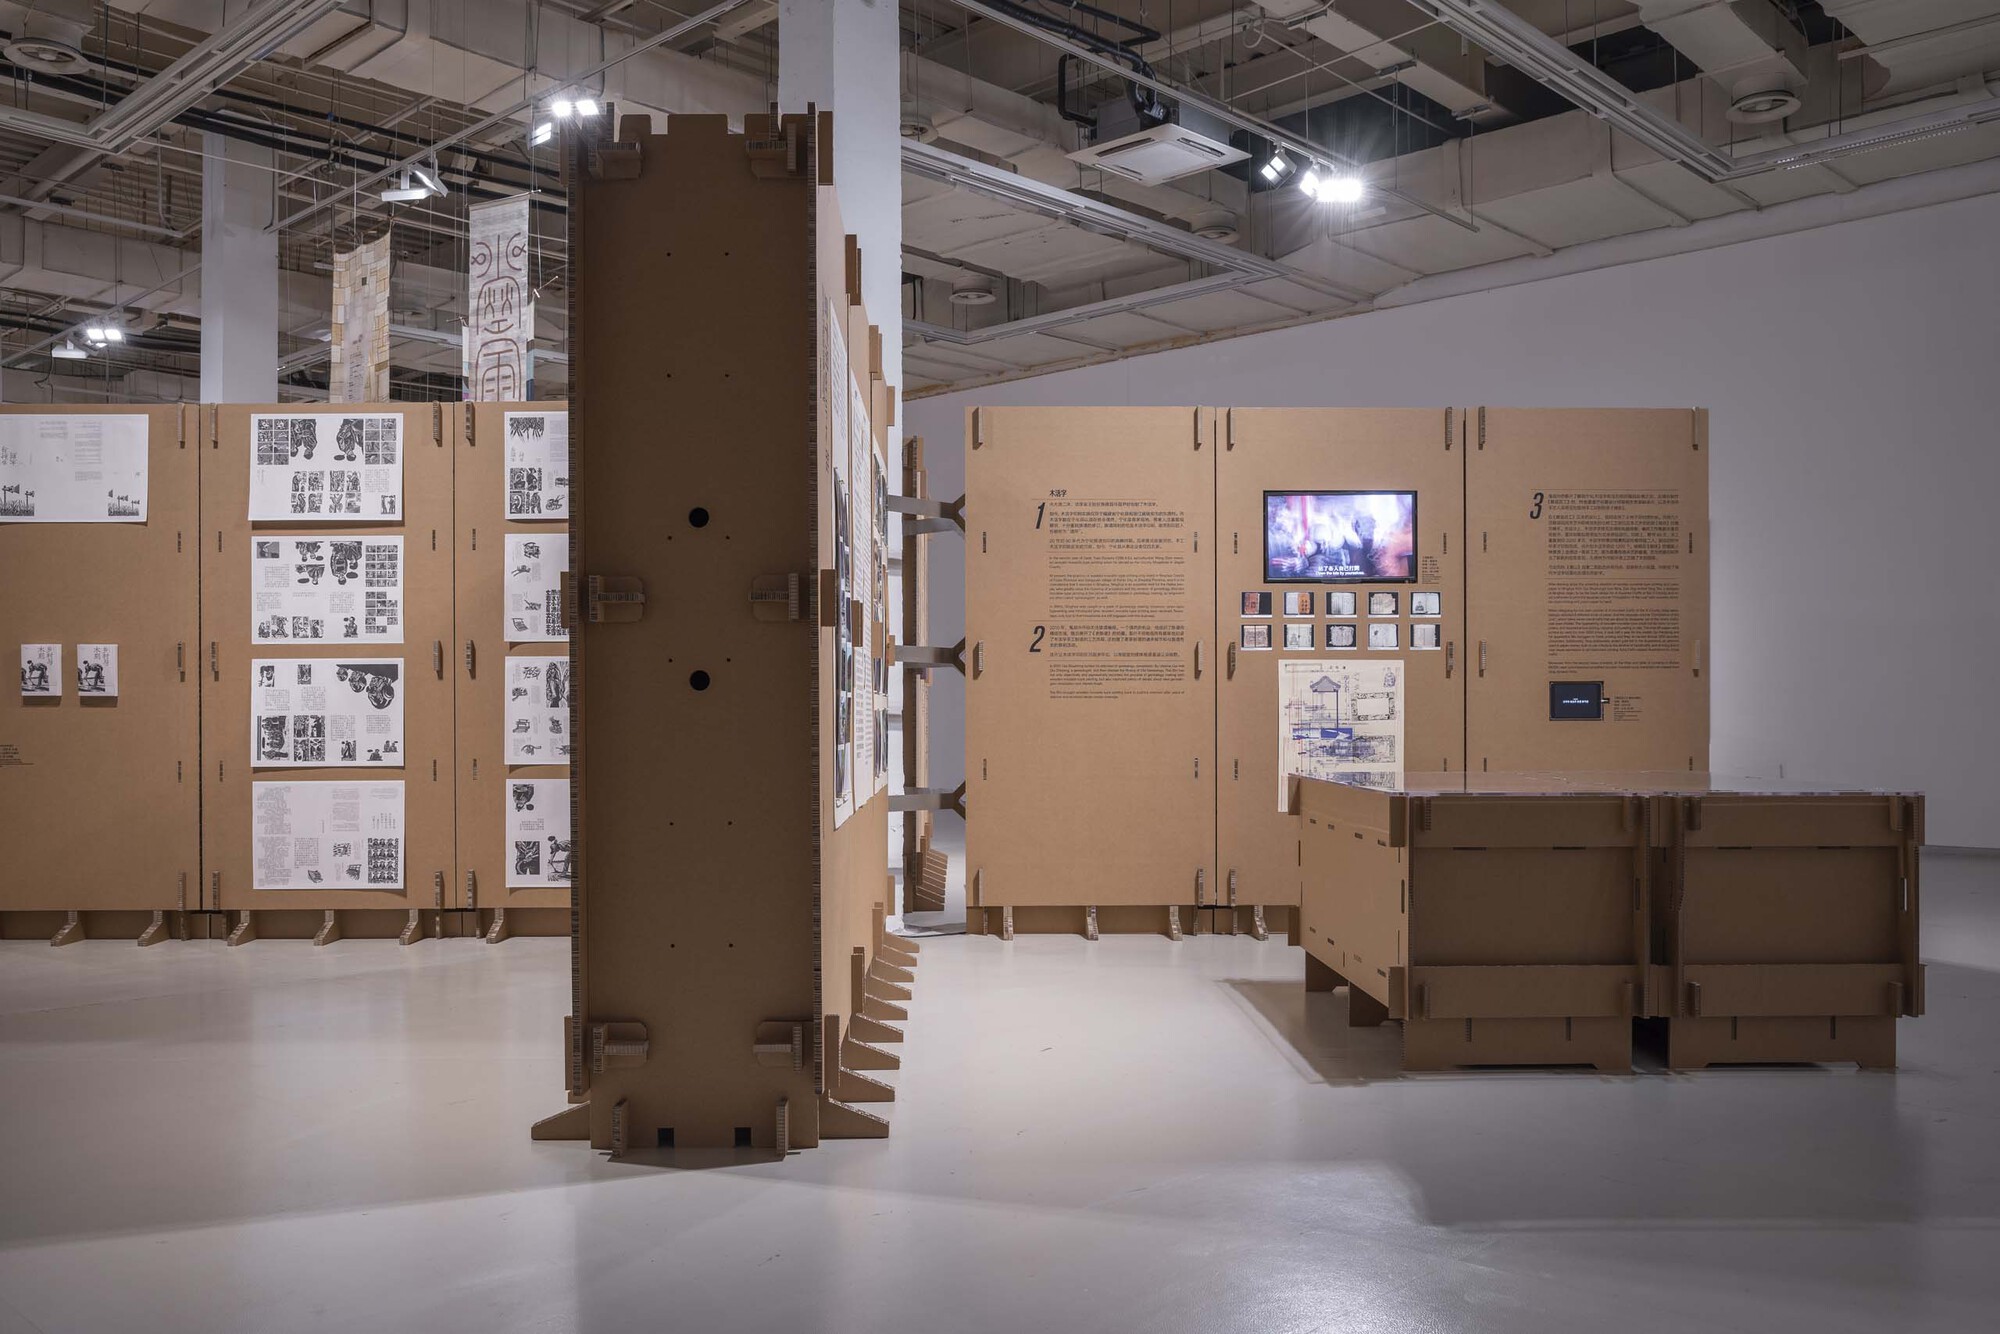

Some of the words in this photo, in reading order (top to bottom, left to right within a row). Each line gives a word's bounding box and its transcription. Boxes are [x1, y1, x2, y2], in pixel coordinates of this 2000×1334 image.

[1049, 489, 1067, 498] 木活字
[1529, 492, 1544, 520] 3
[1036, 502, 1046, 529] 1
[1029, 625, 1046, 653] 2
